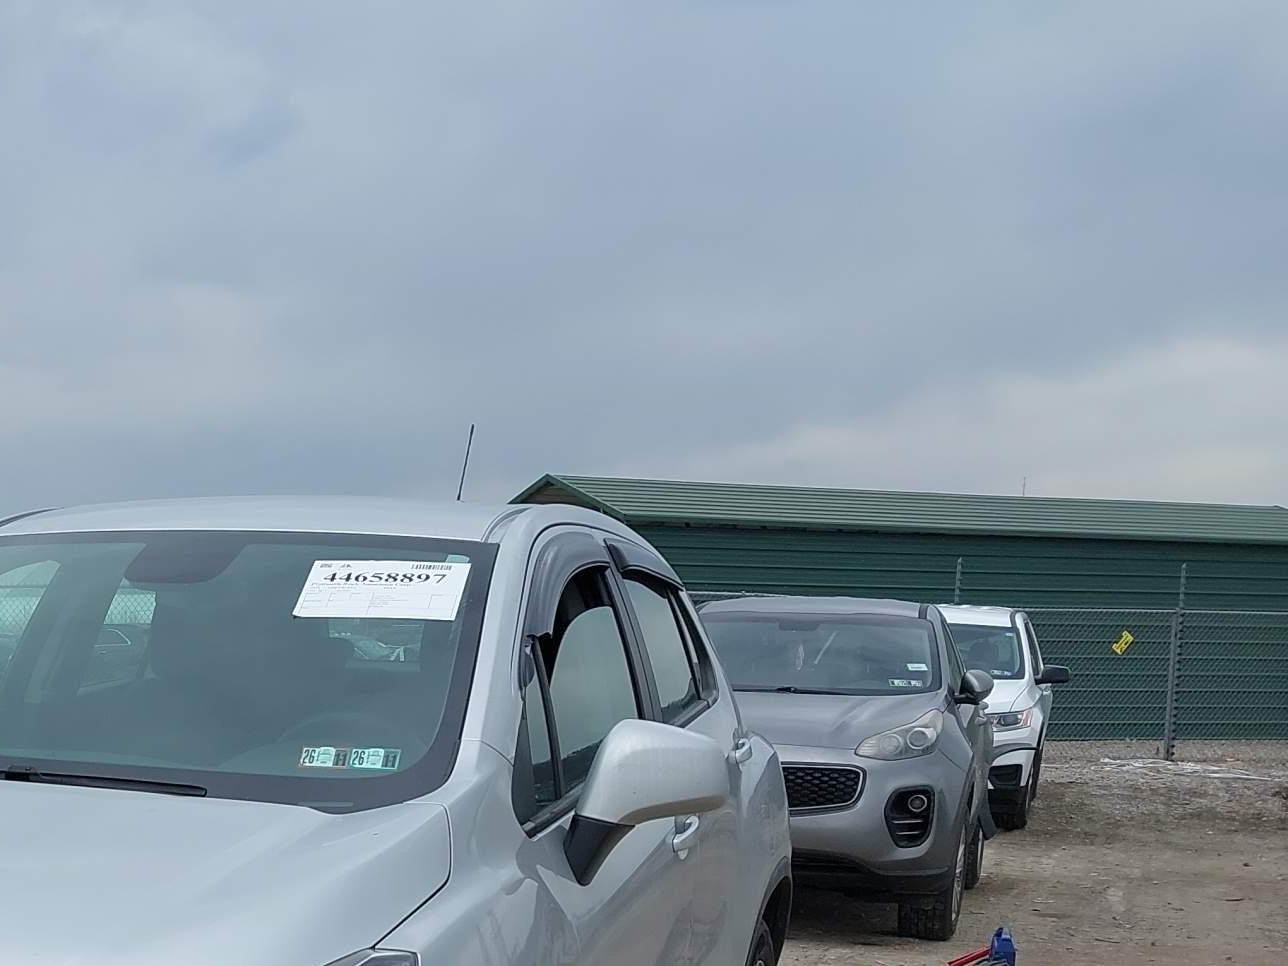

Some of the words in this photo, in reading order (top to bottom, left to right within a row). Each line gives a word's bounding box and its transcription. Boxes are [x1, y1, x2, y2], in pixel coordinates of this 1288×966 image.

[323, 572, 447, 584] 44658897
[302, 749, 316, 764] 26
[352, 750, 366, 766] 26
